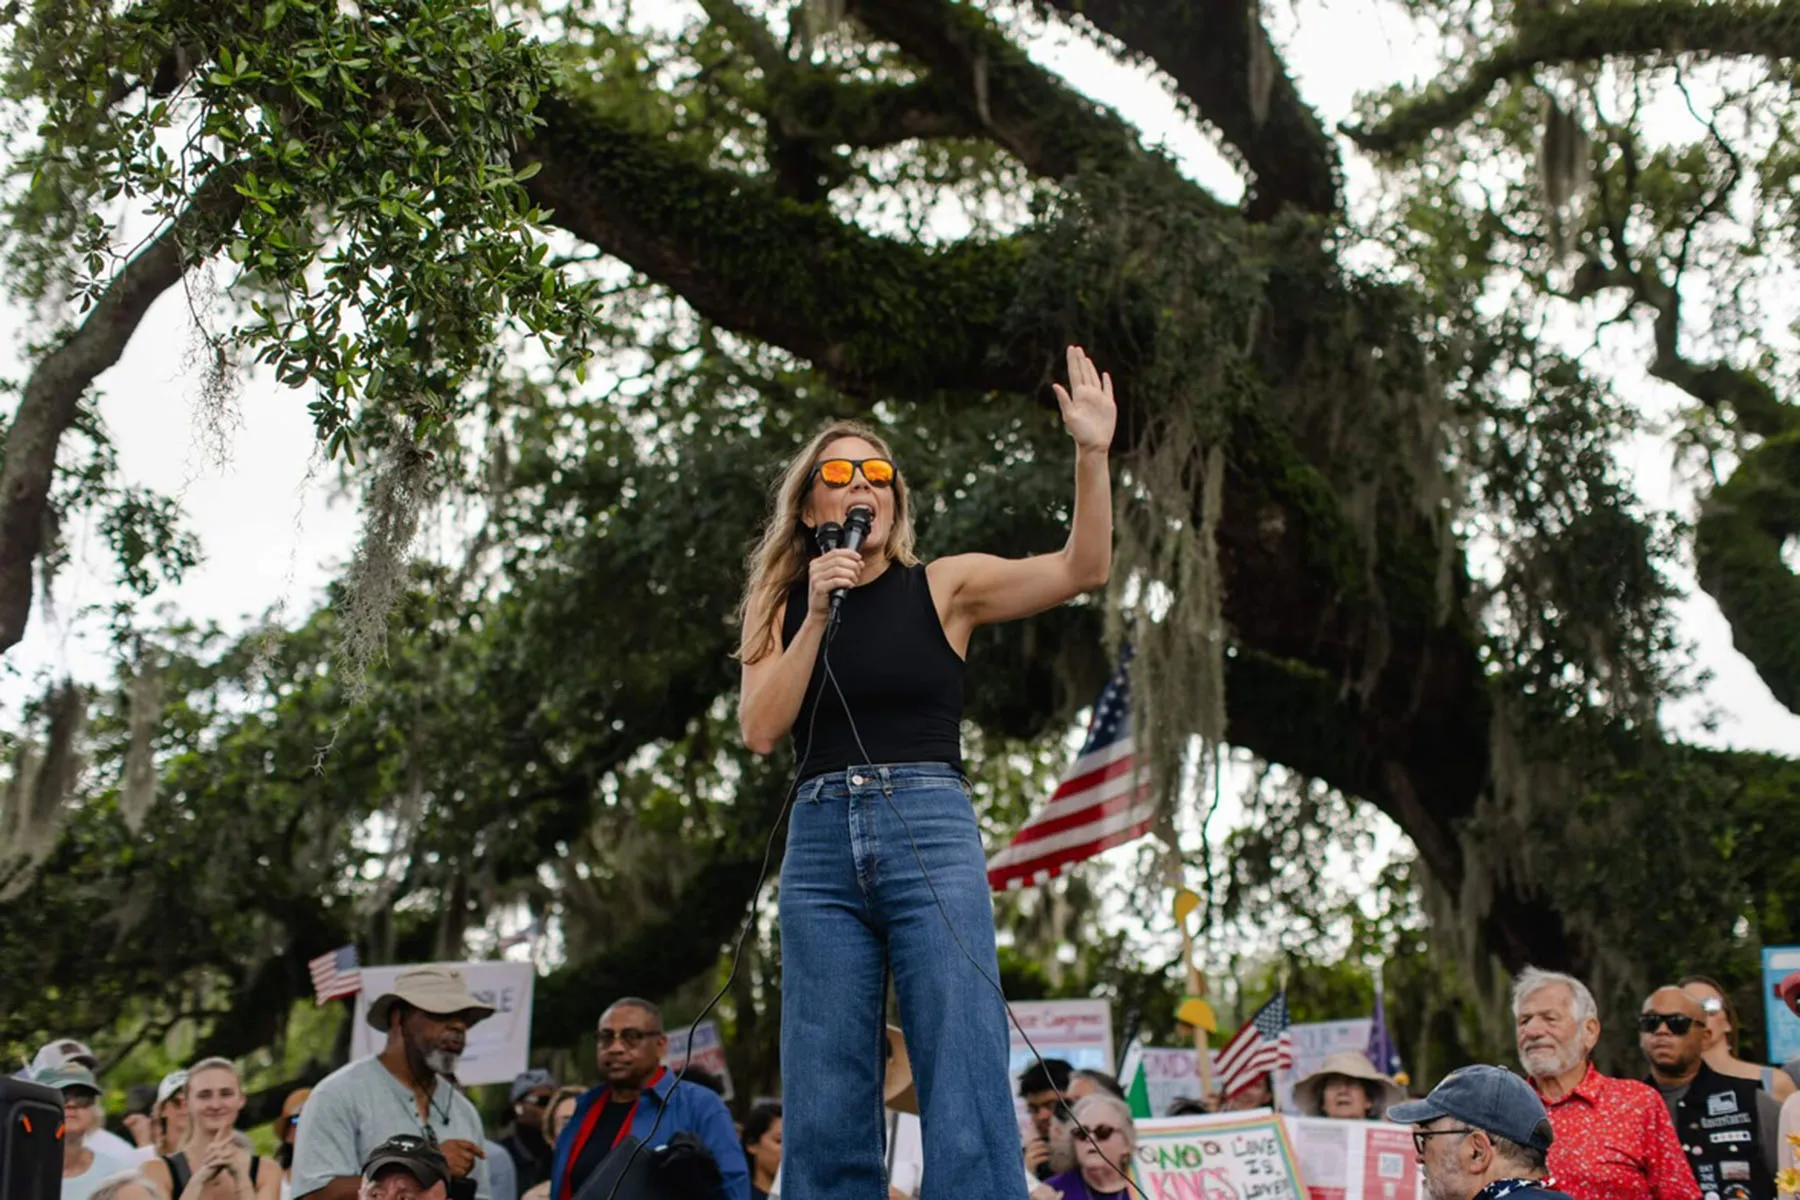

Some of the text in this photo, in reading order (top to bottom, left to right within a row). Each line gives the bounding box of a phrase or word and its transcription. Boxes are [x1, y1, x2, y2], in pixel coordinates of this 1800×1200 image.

[1158, 1143, 1203, 1169] NO
[1230, 1136, 1278, 1158] LOVE
[1244, 1159, 1274, 1176] IS
[1149, 1166, 1240, 1200] KINGS
